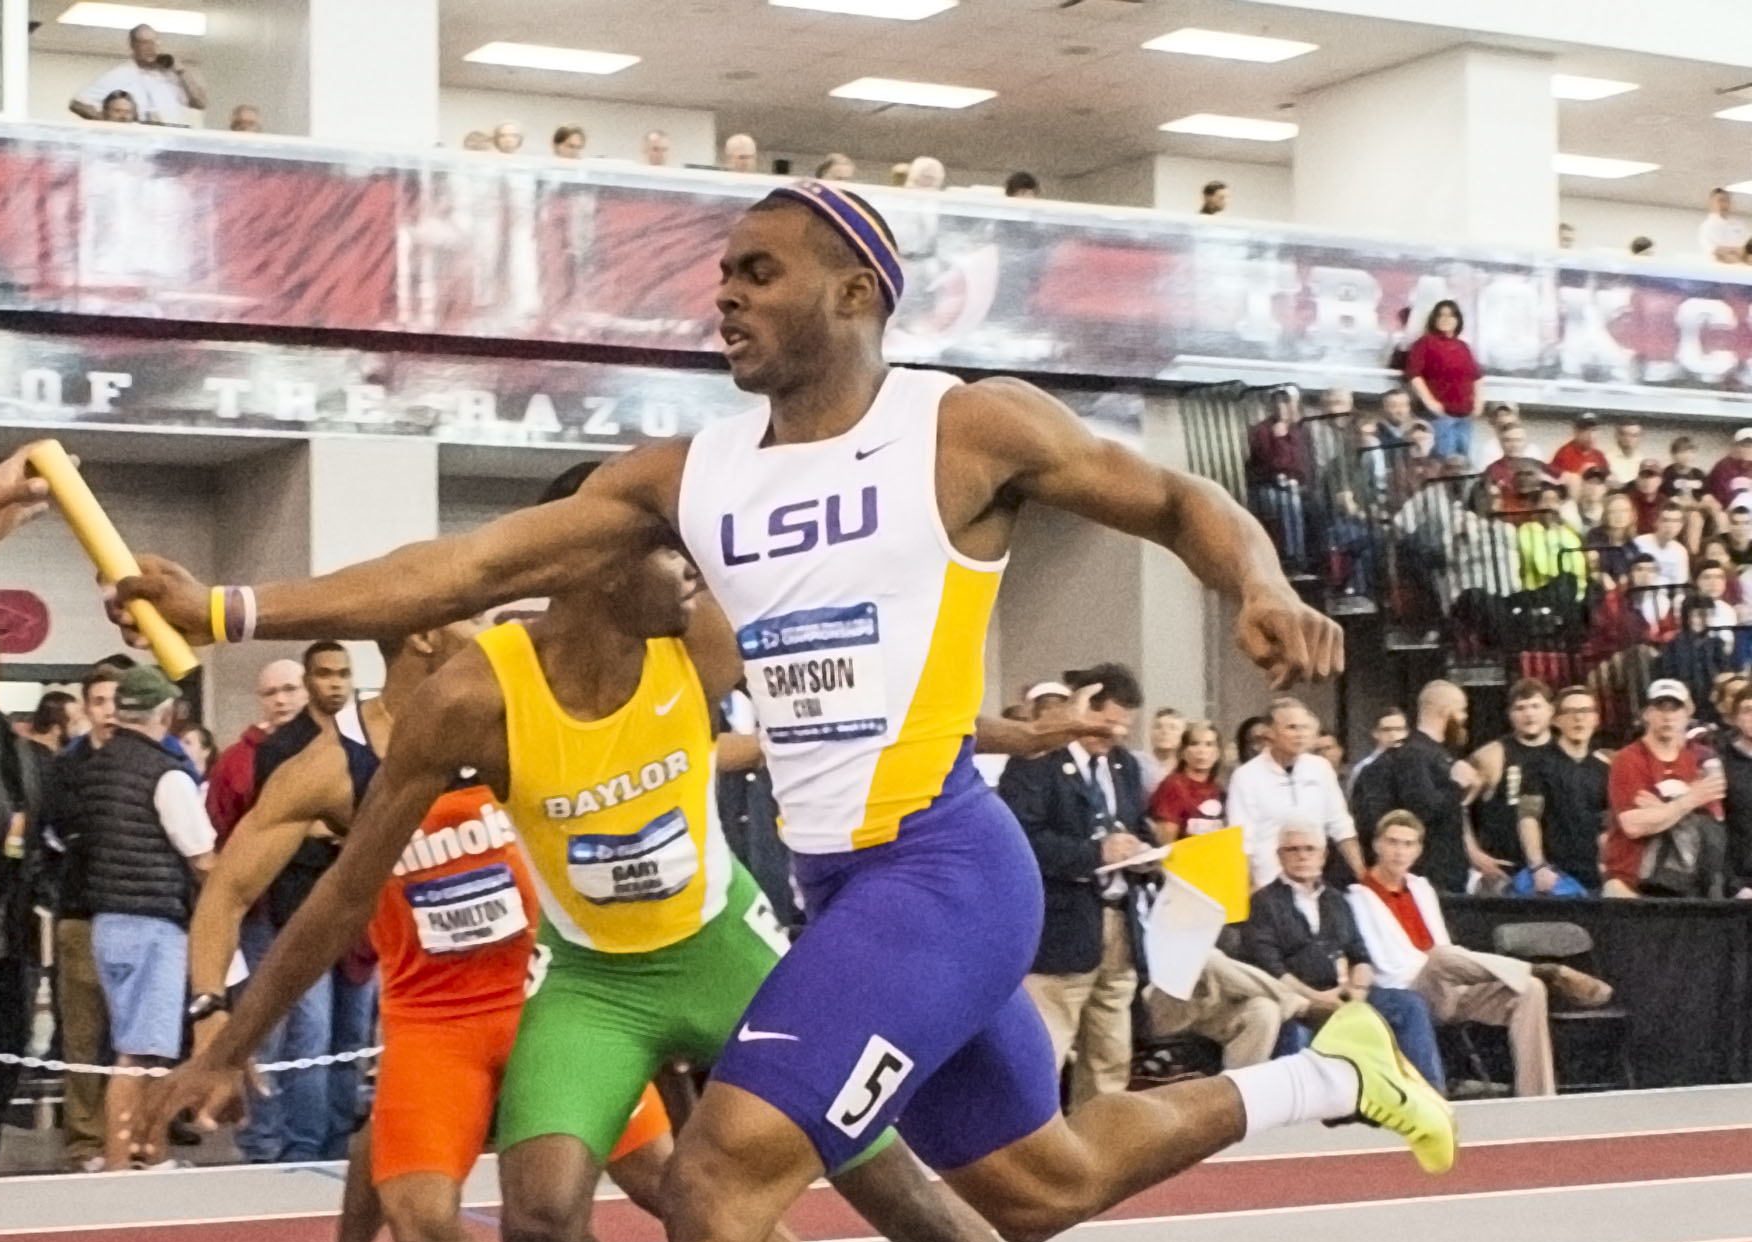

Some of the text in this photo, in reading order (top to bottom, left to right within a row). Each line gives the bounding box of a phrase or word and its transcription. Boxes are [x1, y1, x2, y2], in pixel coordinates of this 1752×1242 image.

[1674, 297, 1752, 375] C
[20, 367, 133, 414] OF
[202, 376, 387, 424] THE
[451, 388, 682, 437] RAZO
[720, 485, 879, 567] LSU
[763, 657, 855, 698] GRAYSON
[543, 749, 690, 820] BAYLOR
[840, 1051, 904, 1127] 5
